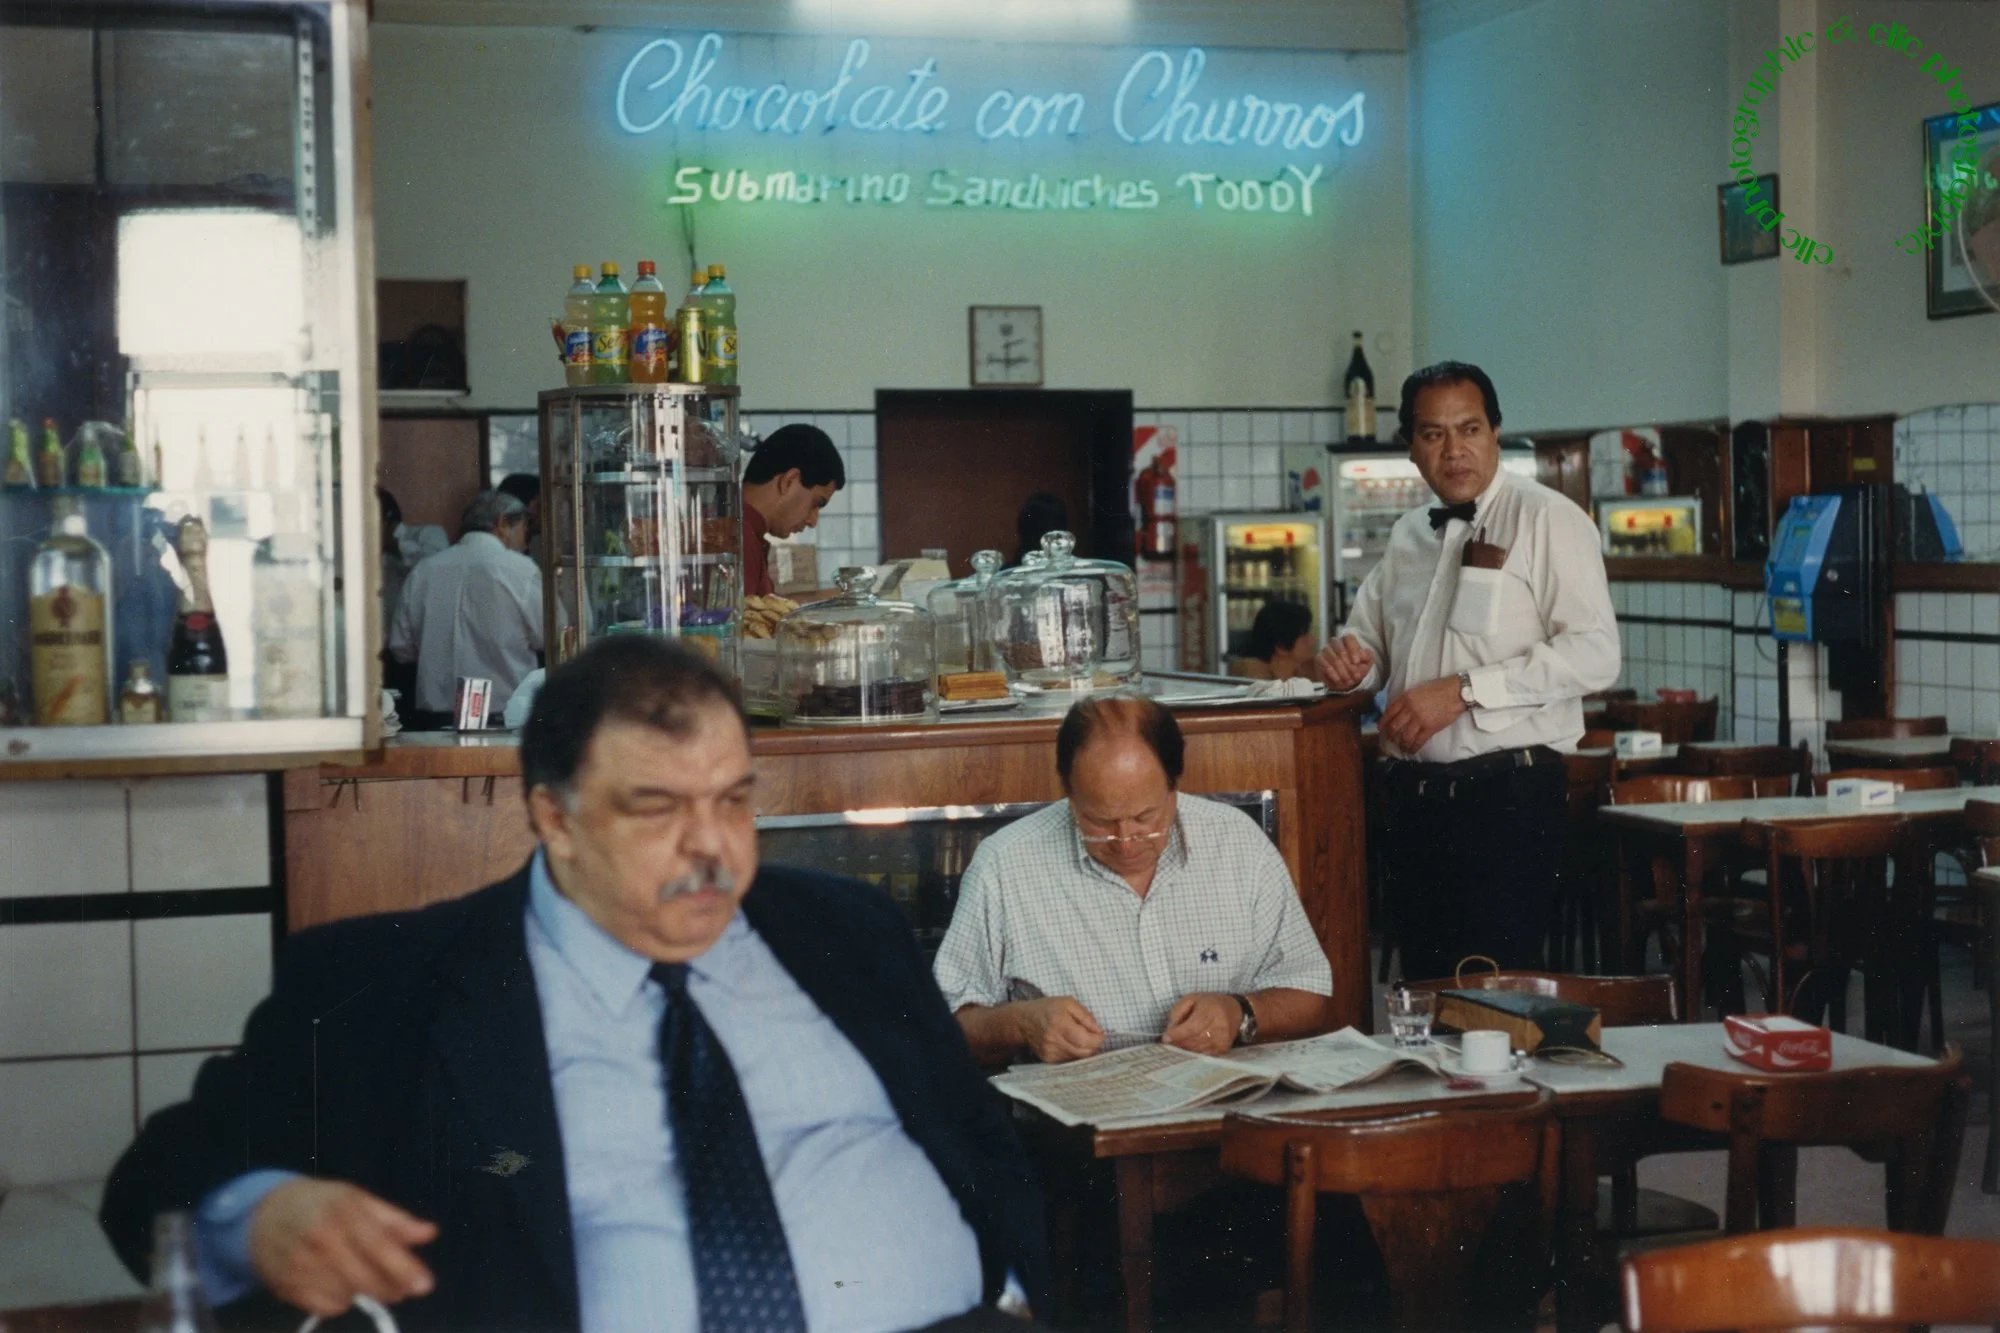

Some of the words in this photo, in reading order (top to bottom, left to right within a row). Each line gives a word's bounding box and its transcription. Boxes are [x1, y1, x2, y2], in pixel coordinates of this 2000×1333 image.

[615, 31, 950, 134] Chocolate
[974, 87, 1086, 142] con
[1112, 46, 1367, 151] Churros
